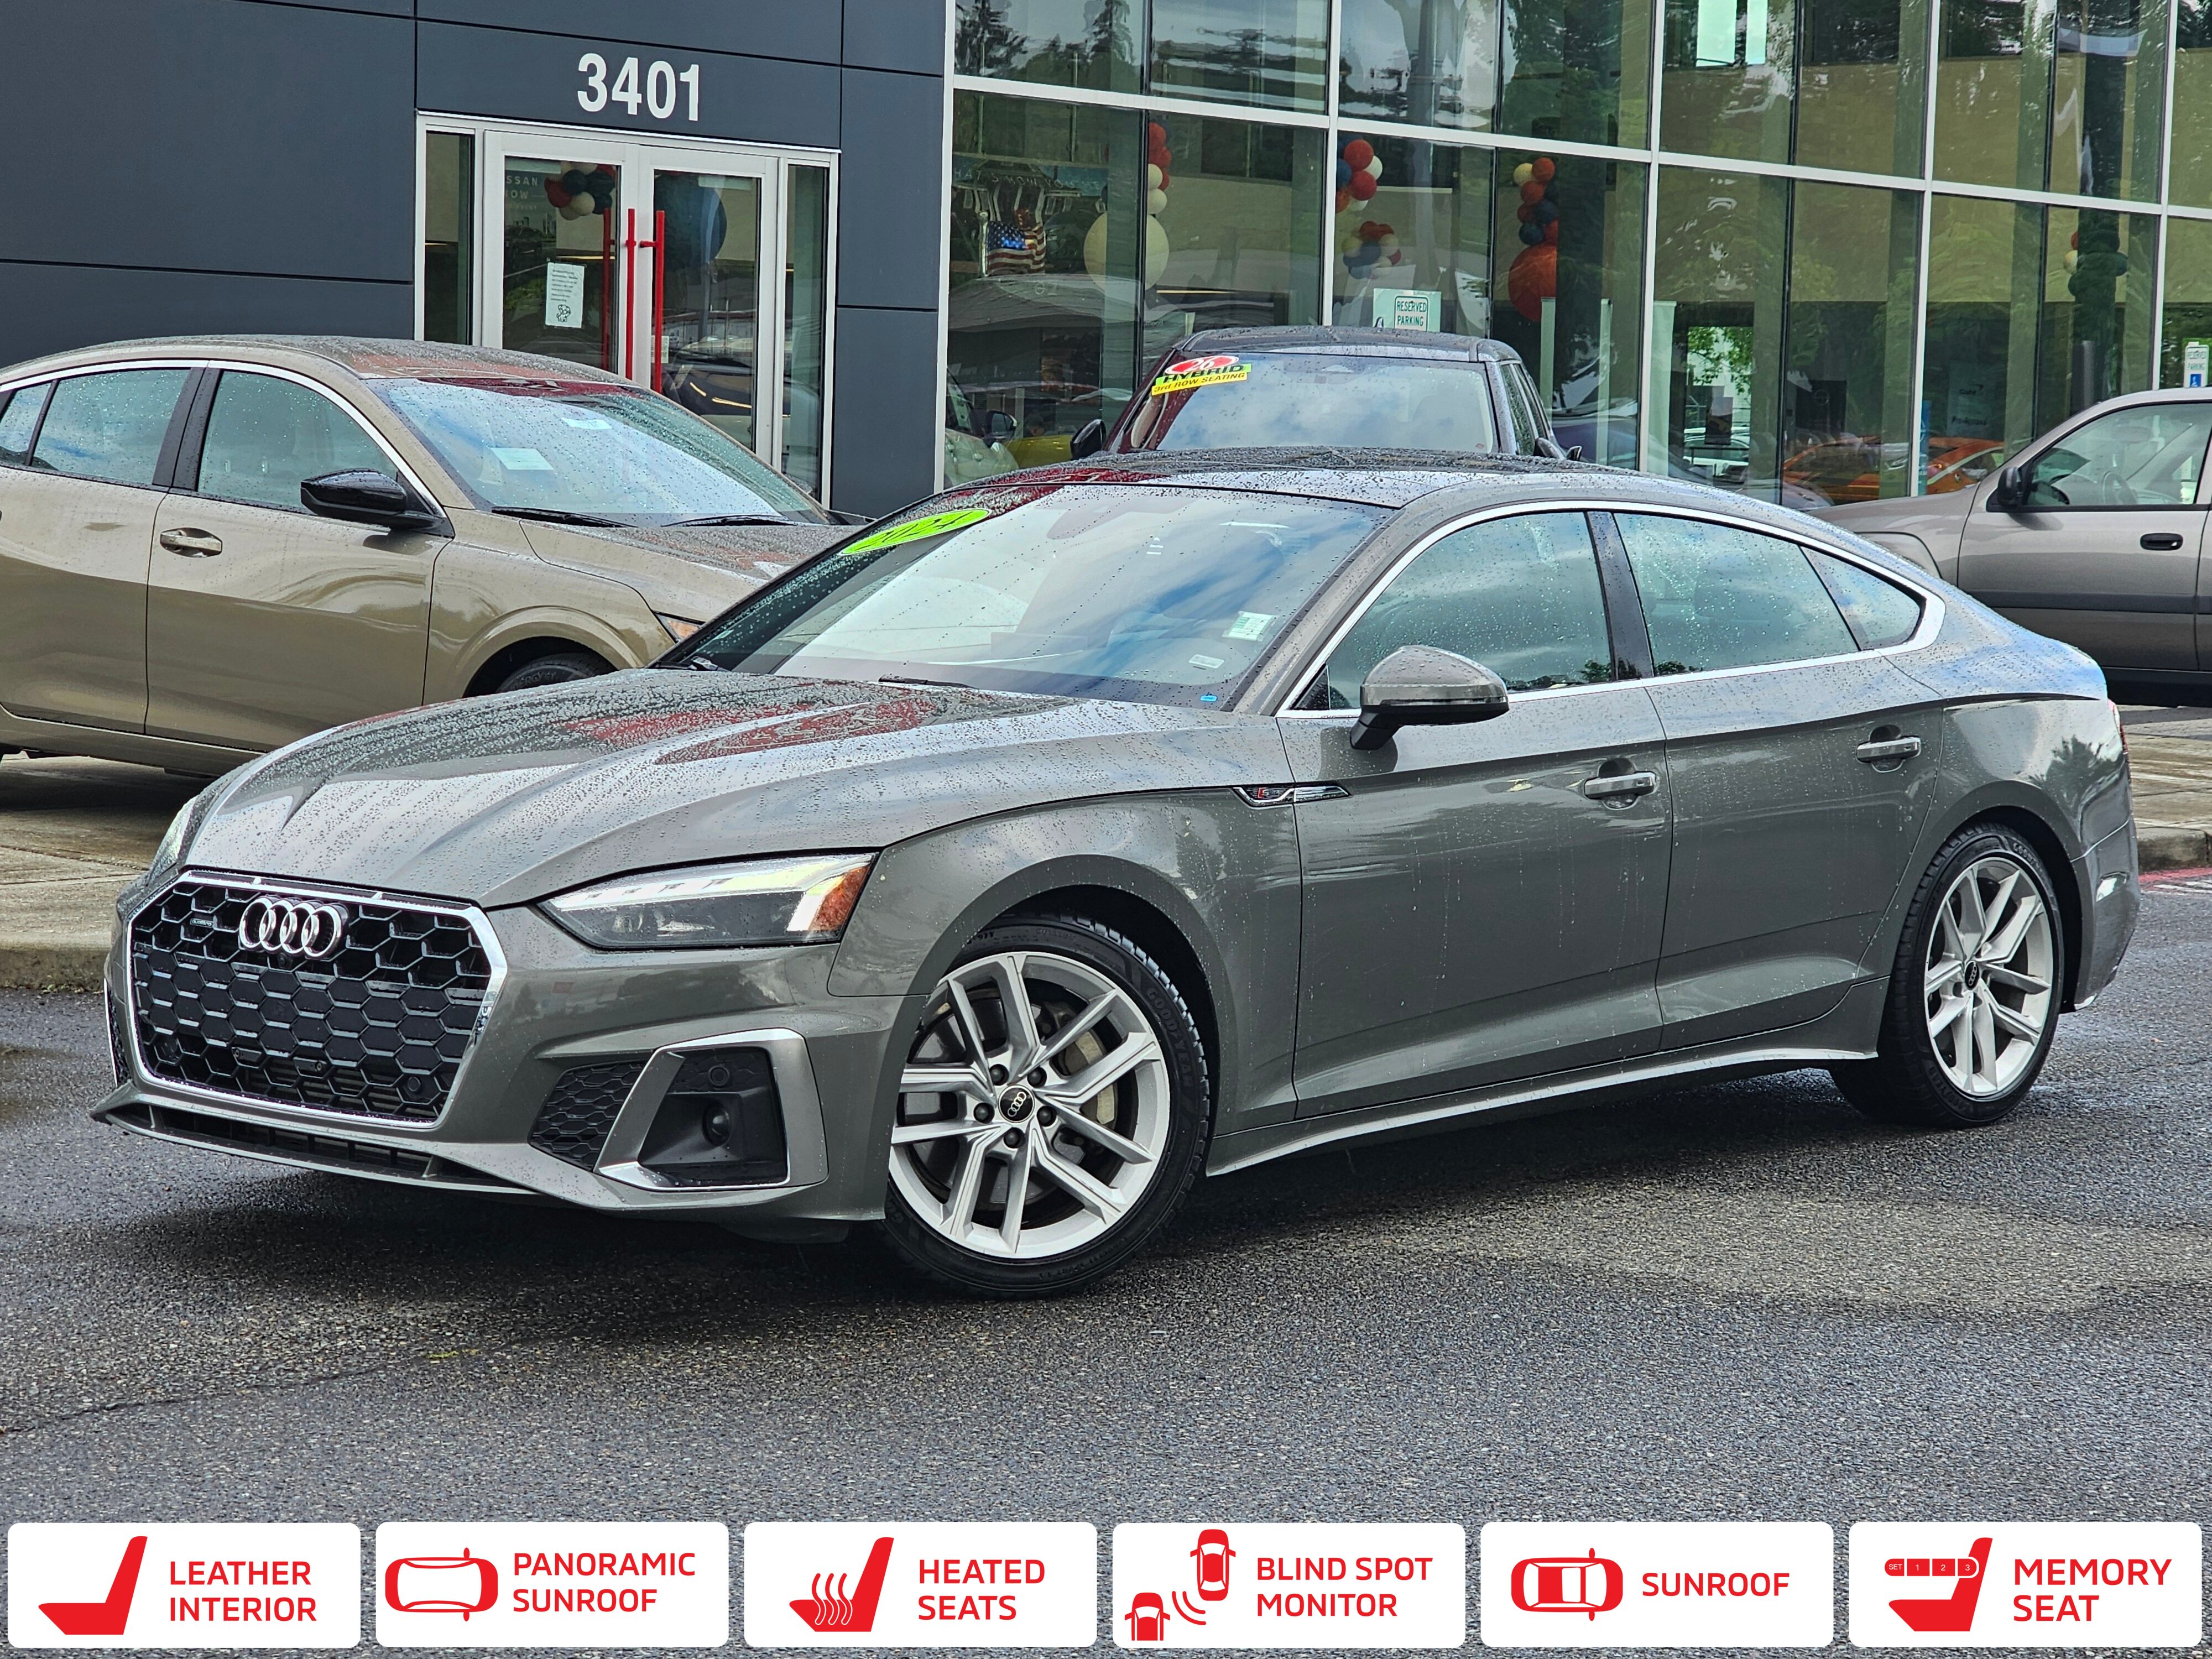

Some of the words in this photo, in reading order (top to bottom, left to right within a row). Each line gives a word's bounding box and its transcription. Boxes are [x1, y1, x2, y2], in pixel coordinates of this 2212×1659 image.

[577, 53, 699, 121] 3401
[1397, 300, 1427, 312] RESERVED
[1397, 315, 1424, 326] PARKING
[1188, 358, 1215, 370] 26
[1162, 364, 1245, 383] HYBRID
[1154, 384, 1171, 393] 3rd
[1173, 379, 1199, 388] ROW
[1201, 372, 1245, 383] SEATING
